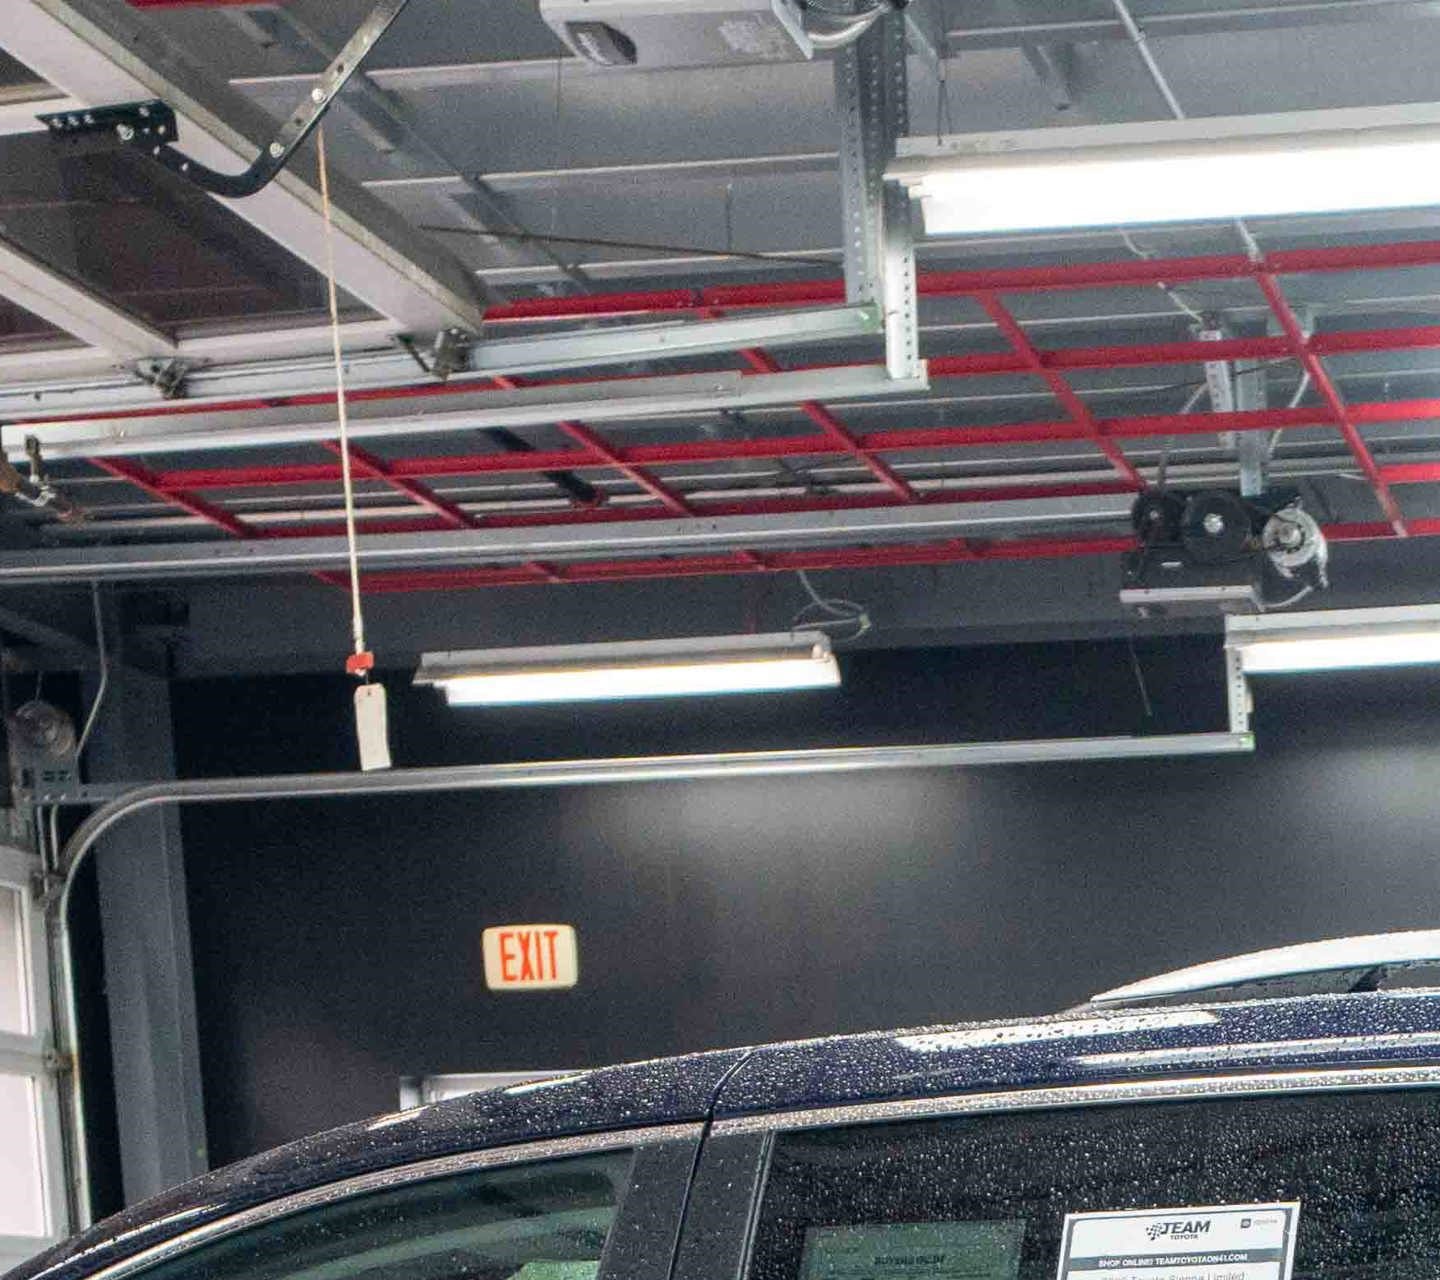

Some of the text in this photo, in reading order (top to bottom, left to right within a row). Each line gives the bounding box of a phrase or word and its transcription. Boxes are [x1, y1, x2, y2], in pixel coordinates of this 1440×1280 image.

[498, 931, 558, 981] EXIT
[1160, 1220, 1211, 1235] TEAM
[1098, 1260, 1120, 1268] SHOP
